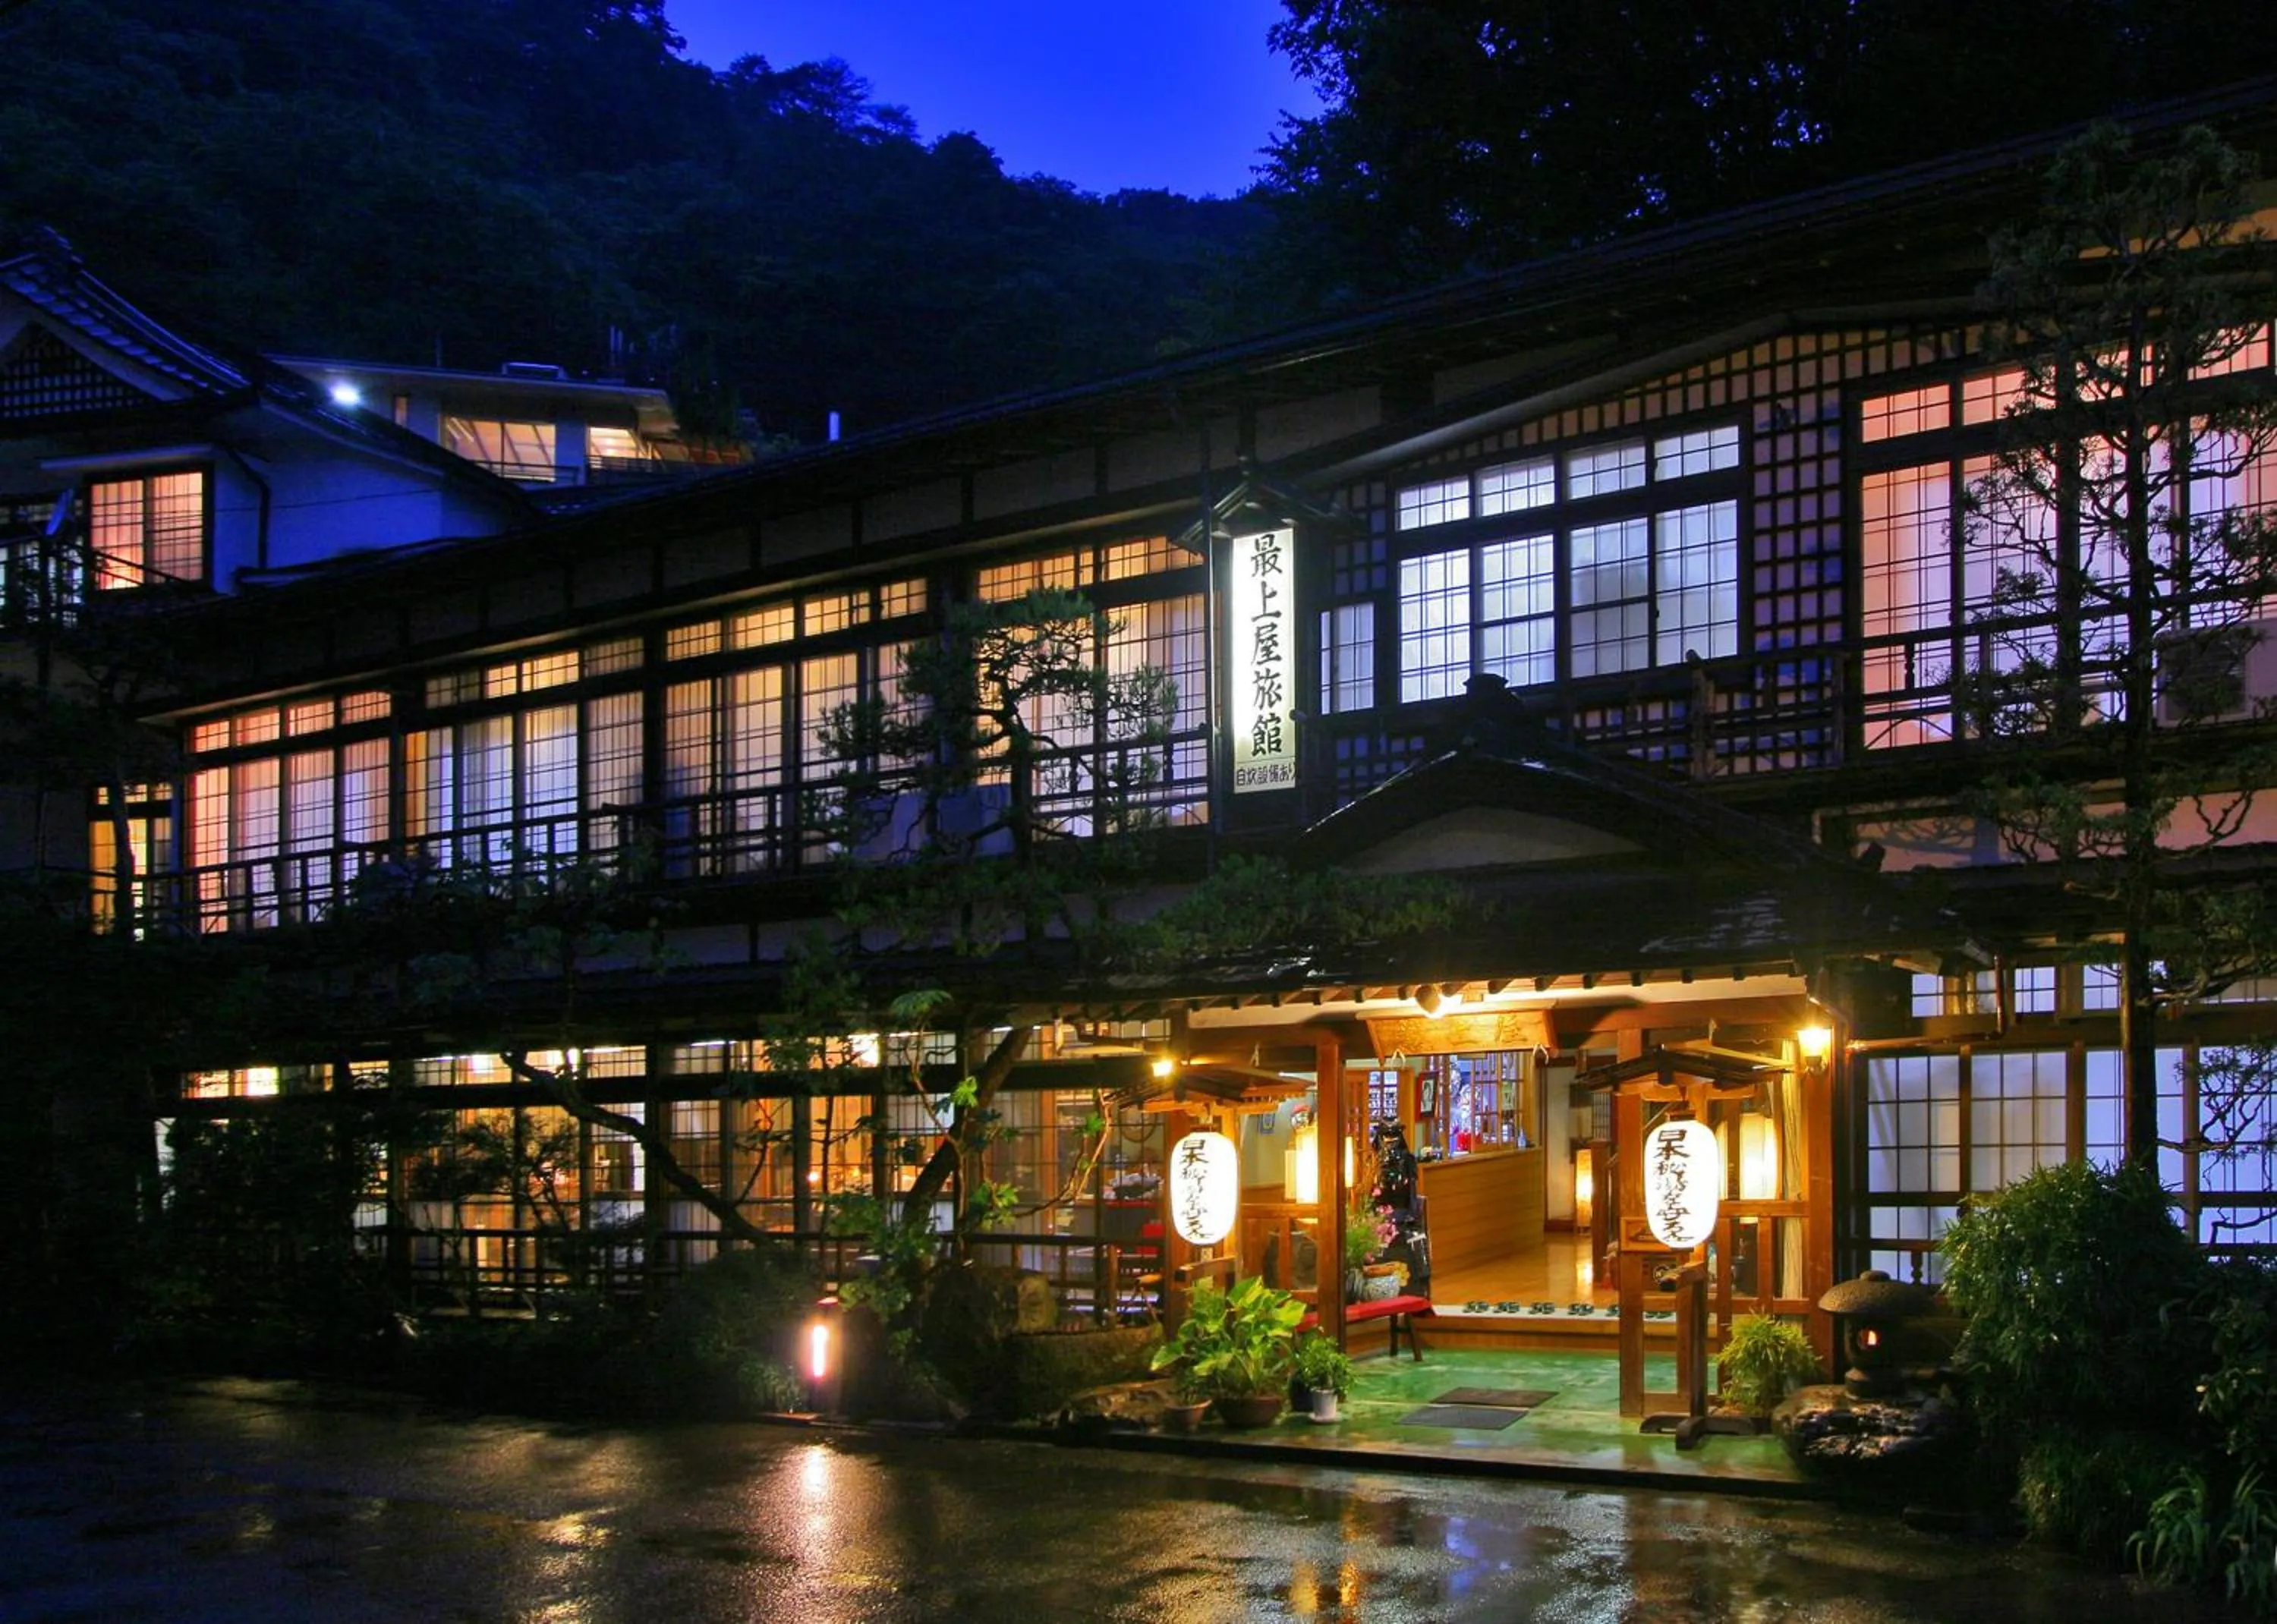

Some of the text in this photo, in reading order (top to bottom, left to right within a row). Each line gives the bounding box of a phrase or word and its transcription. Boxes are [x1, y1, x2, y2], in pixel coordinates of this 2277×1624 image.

[1250, 533, 1283, 757] 最上屋旅館
